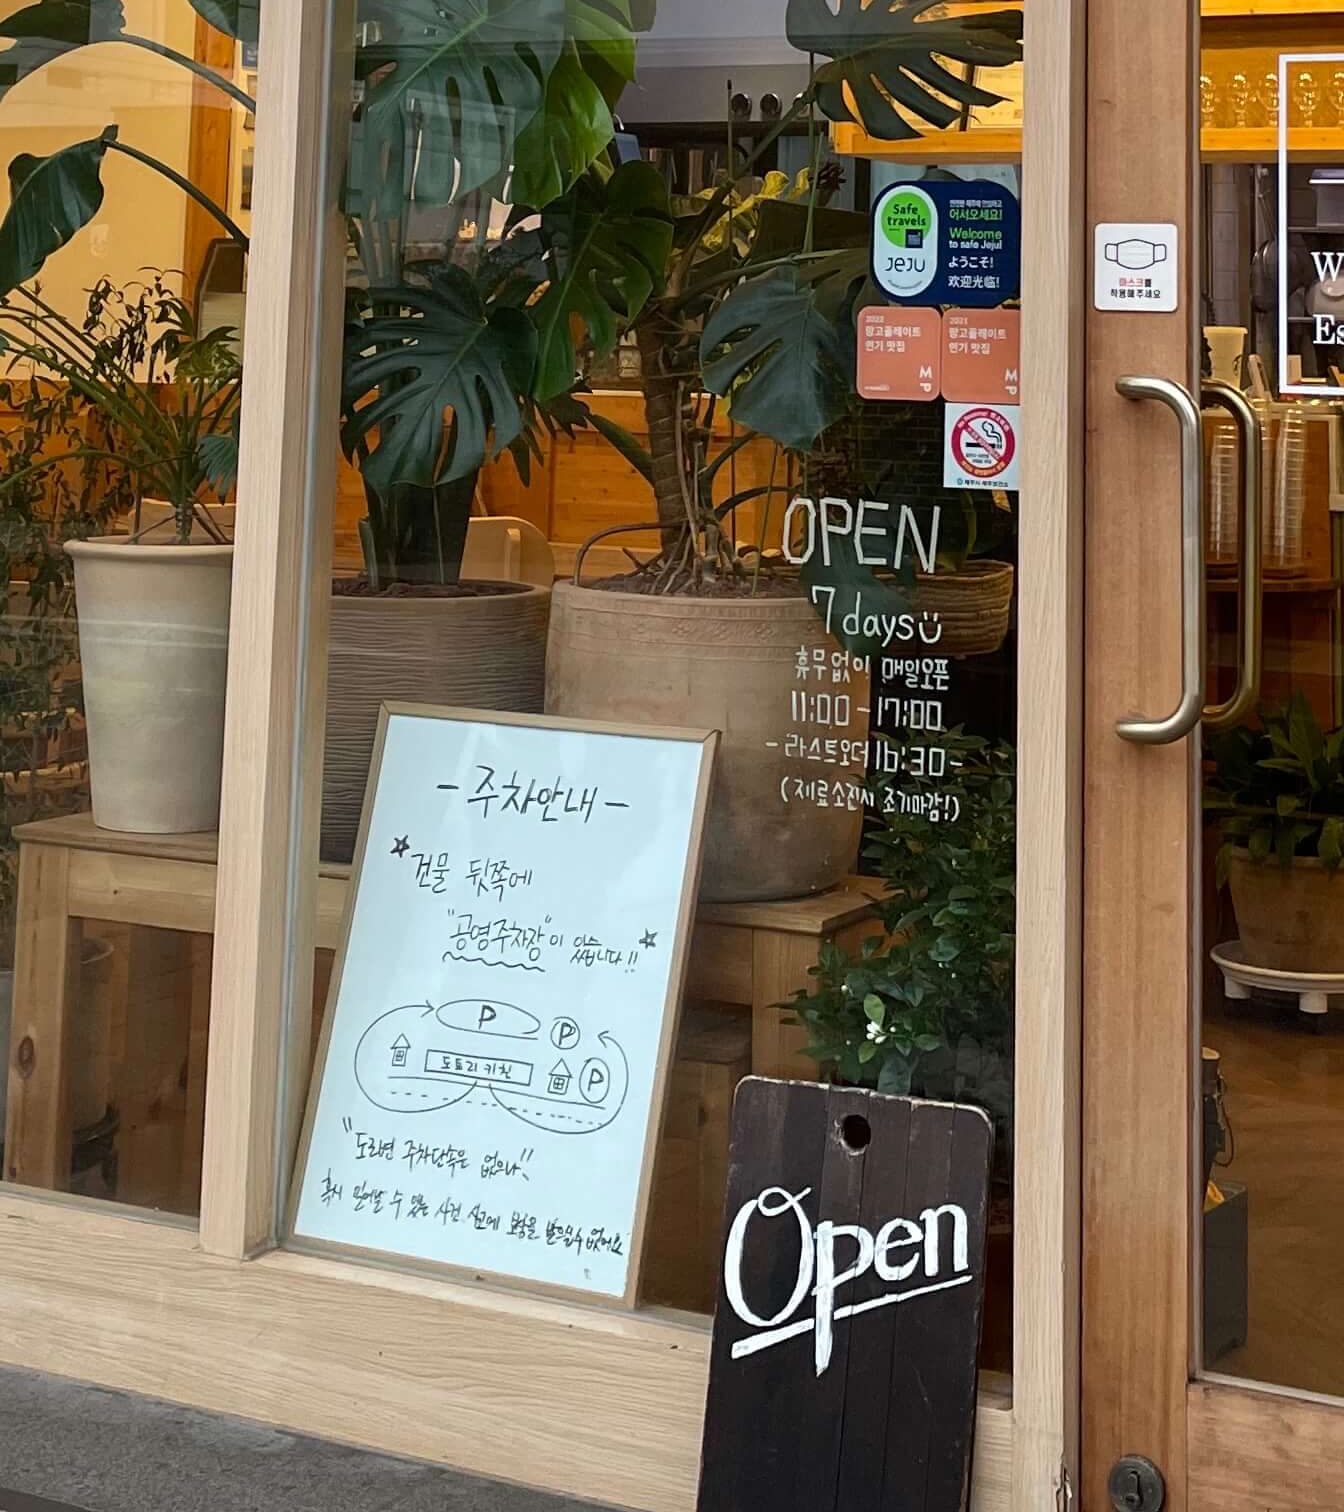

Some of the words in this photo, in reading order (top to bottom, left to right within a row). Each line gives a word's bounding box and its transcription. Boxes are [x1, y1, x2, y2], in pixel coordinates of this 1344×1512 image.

[887, 215, 926, 226] travels
[892, 203, 919, 215] Safe
[949, 209, 1003, 221] 어서오세요!
[949, 227, 1003, 239] Welcome
[948, 256, 994, 268] ようこそ!
[782, 496, 941, 574] OPEN
[812, 585, 836, 634] 7
[842, 591, 915, 648] days
[795, 644, 871, 684] 휴무없이
[881, 657, 951, 691] 매일오픈
[791, 690, 850, 727] 11:00
[877, 696, 943, 732] 17:00
[411, 851, 451, 895] 건물
[465, 857, 533, 903] 뒷쪽에
[478, 1004, 497, 1030] P
[724, 1186, 969, 1378] Open
